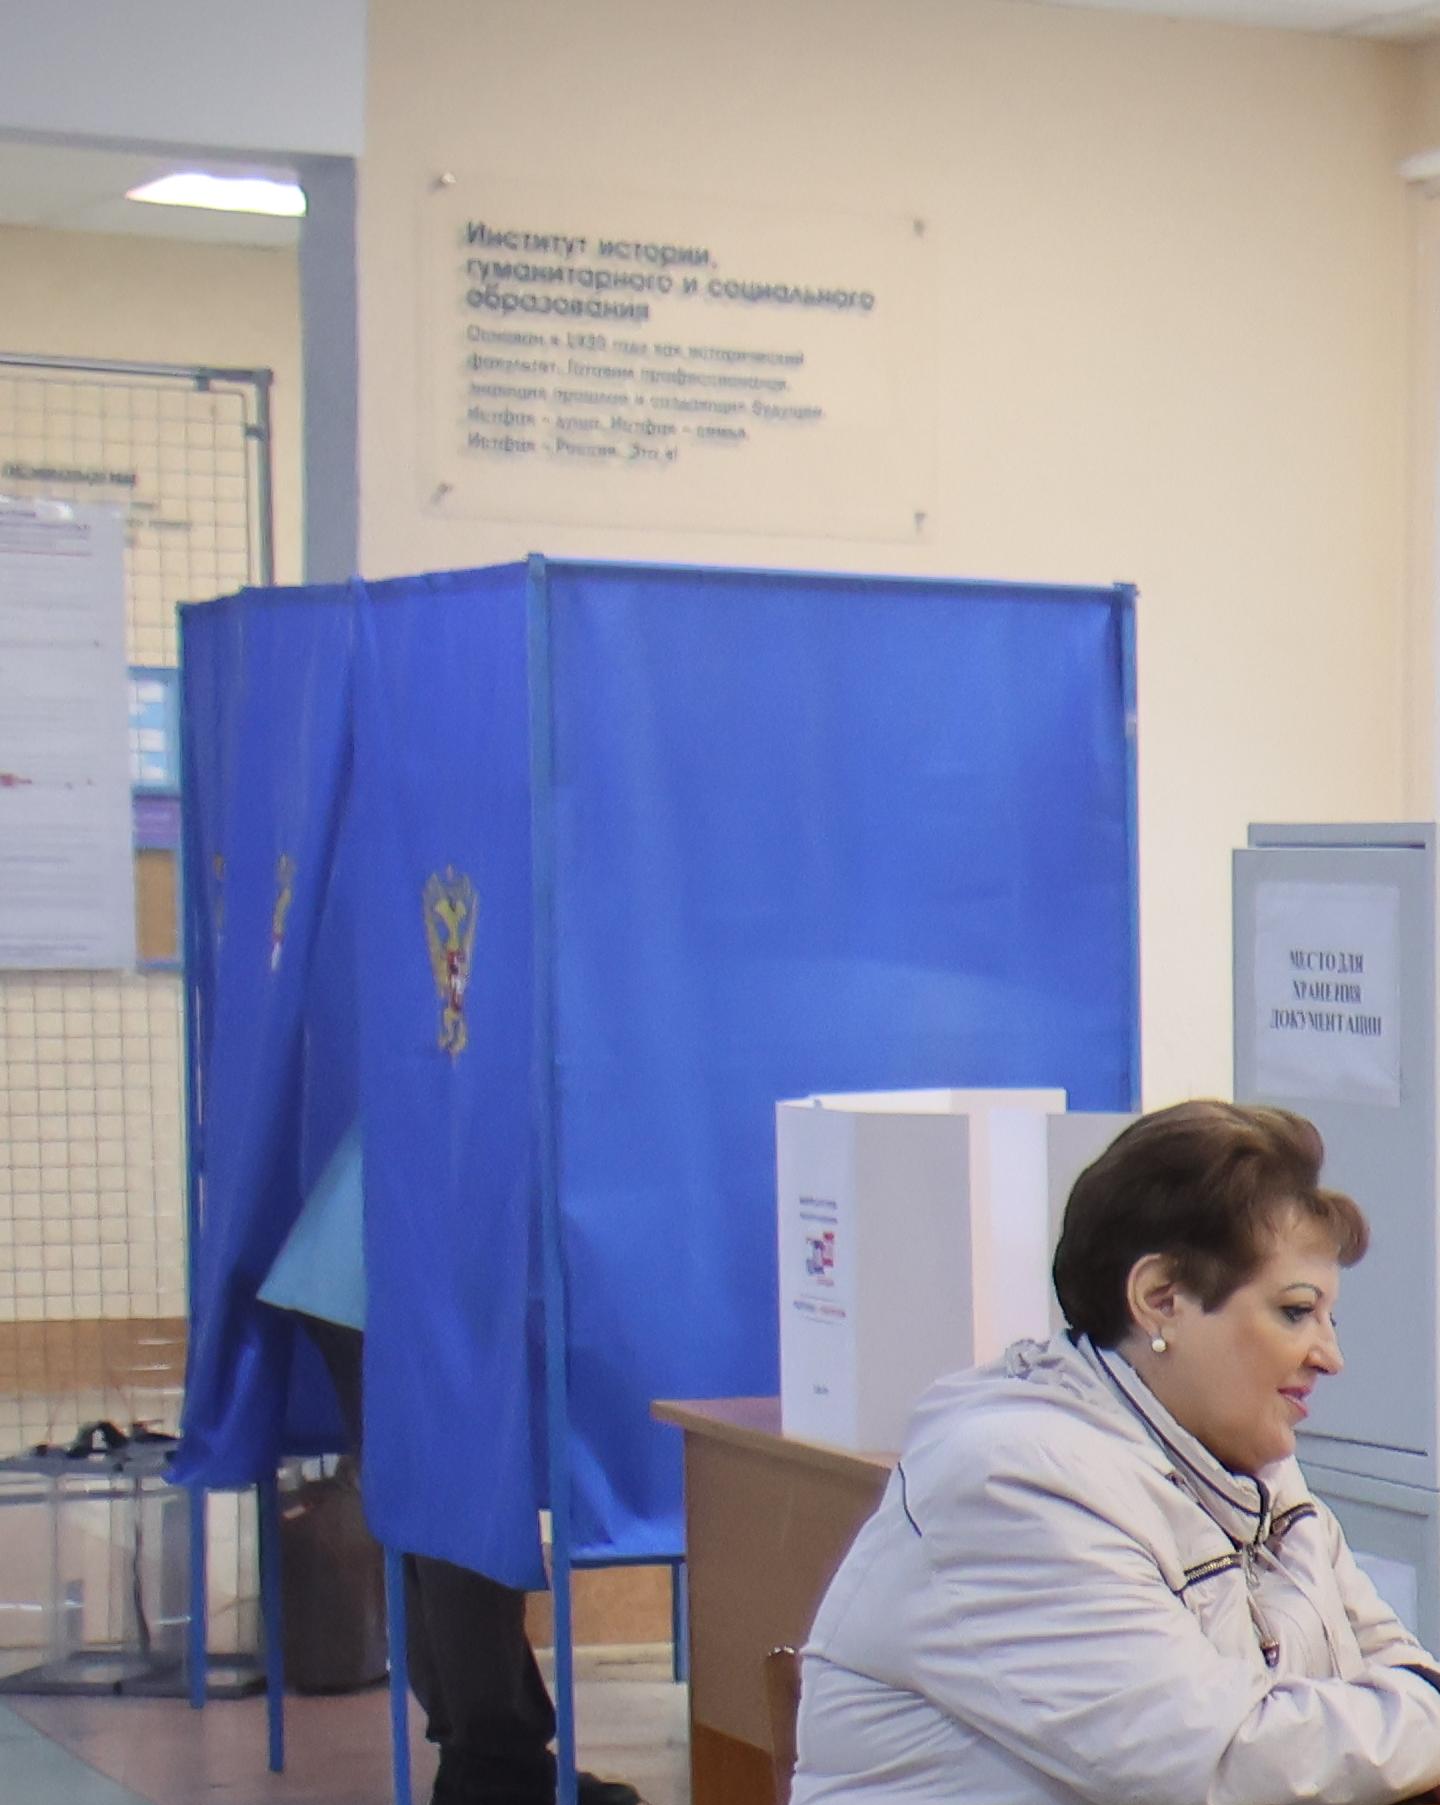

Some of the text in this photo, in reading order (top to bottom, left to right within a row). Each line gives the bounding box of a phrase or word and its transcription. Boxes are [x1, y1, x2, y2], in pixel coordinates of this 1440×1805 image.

[466, 220, 586, 258] Институт
[467, 258, 875, 311] гуманитарного и социального
[466, 282, 649, 322] образования
[1289, 949, 1364, 974] МЕСТО ДЛЯ
[1292, 980, 1362, 1005] ХРАНЕНИЯ
[1269, 1008, 1382, 1037] ДОКУМЕНТАЦИИ
